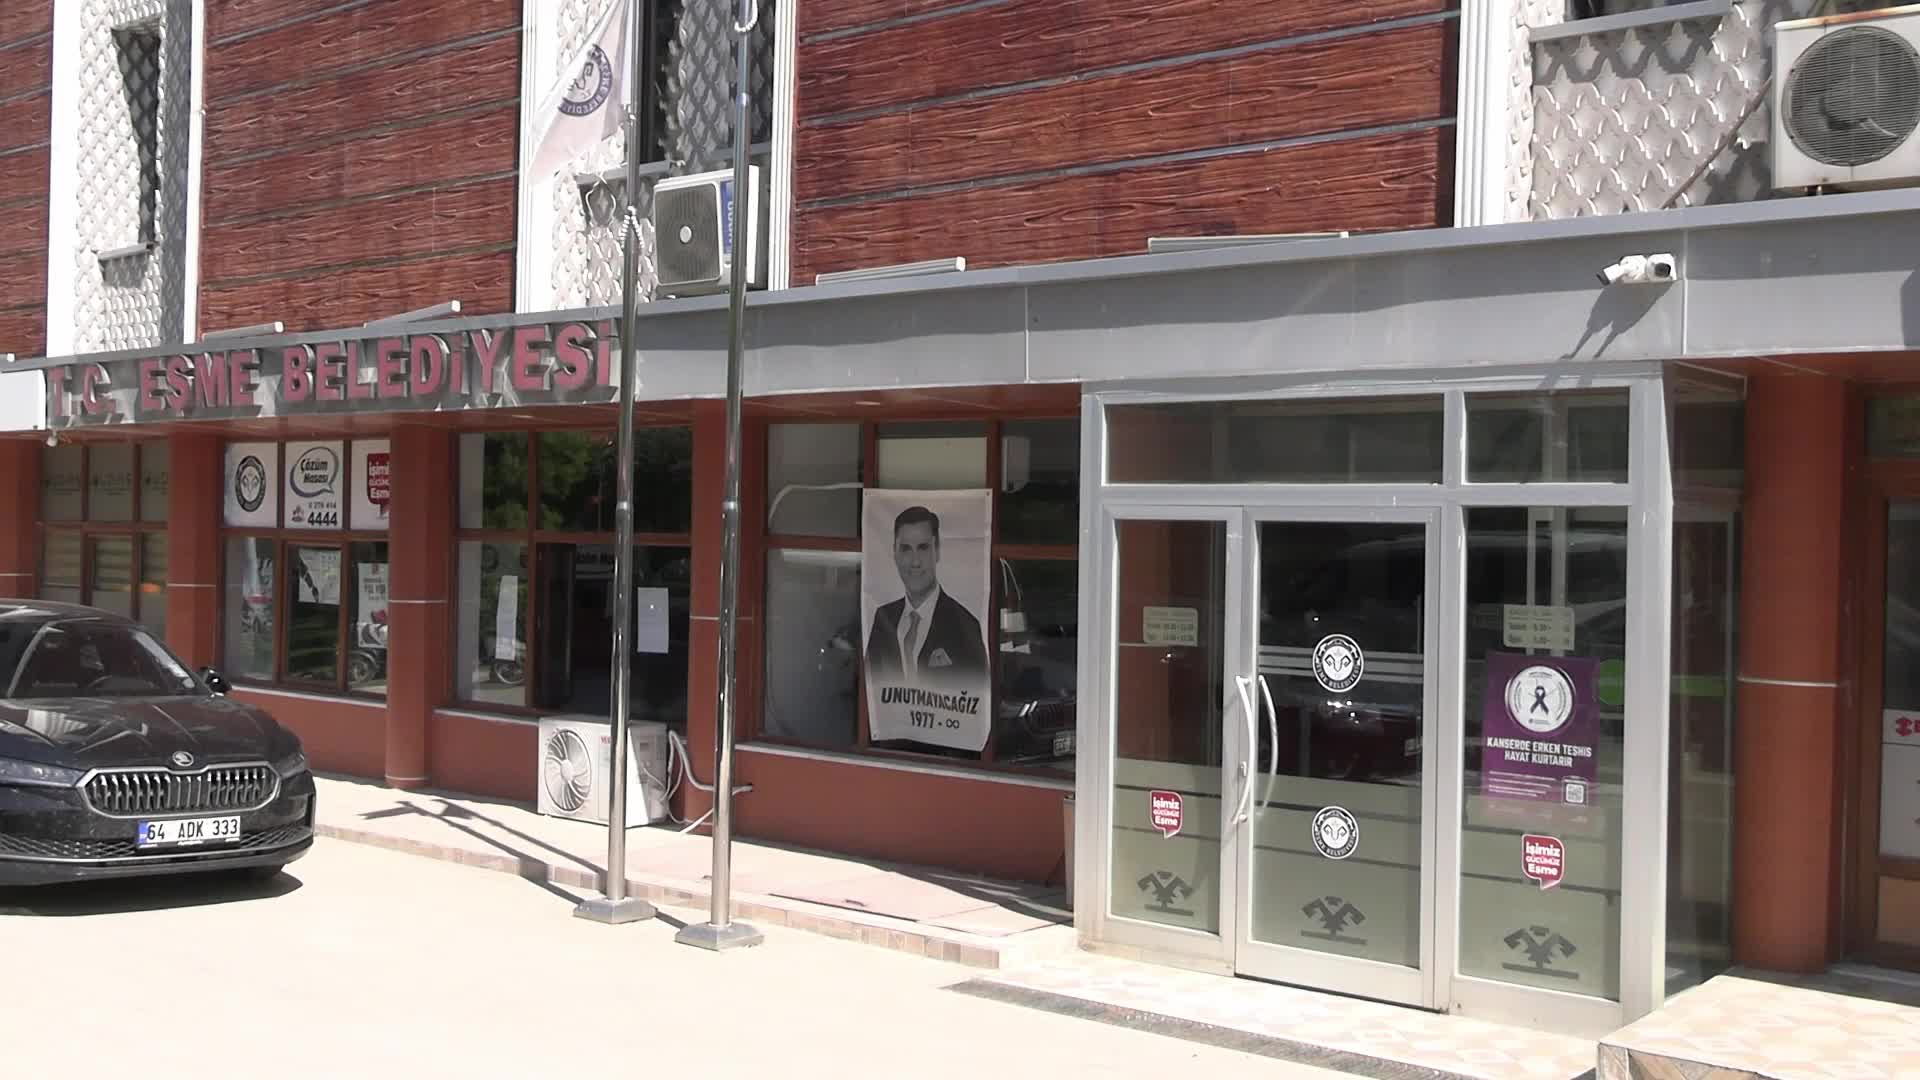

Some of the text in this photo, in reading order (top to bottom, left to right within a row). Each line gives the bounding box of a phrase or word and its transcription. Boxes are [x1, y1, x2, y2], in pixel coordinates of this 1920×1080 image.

[284, 320, 613, 401] BELEDİYESİ
[307, 511, 337, 526] 4444
[881, 687, 980, 715] UNUTMAYACAĞIZ
[910, 710, 934, 729] 1977
[1486, 736, 1531, 751] KANSERDE
[1532, 742, 1561, 754] ERKEN
[1504, 750, 1574, 768] HAYAT KURTARIR
[147, 824, 165, 840] 64
[178, 820, 204, 838] ADK
[212, 818, 238, 836] 333
